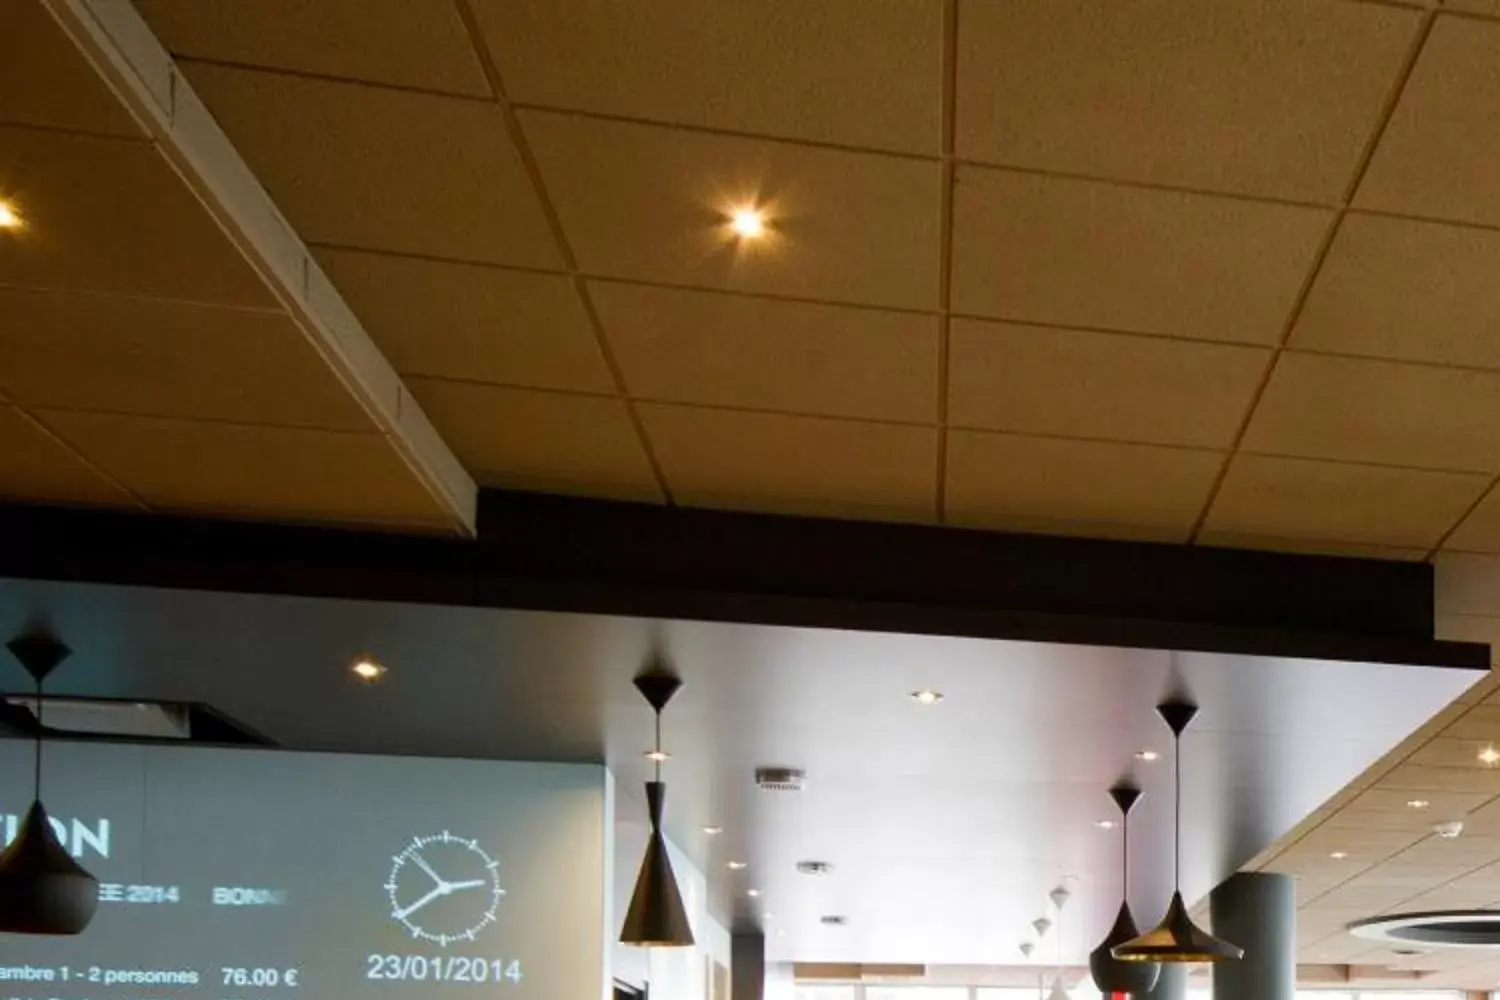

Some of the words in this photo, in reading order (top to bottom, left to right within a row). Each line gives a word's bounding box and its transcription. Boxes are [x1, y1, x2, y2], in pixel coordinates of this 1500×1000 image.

[60, 966, 69, 981] 1
[88, 966, 101, 982] 2
[104, 969, 199, 986] personnes
[221, 967, 278, 987] 76.00
[284, 969, 298, 987] €
[367, 954, 521, 982] 23/01/2014
